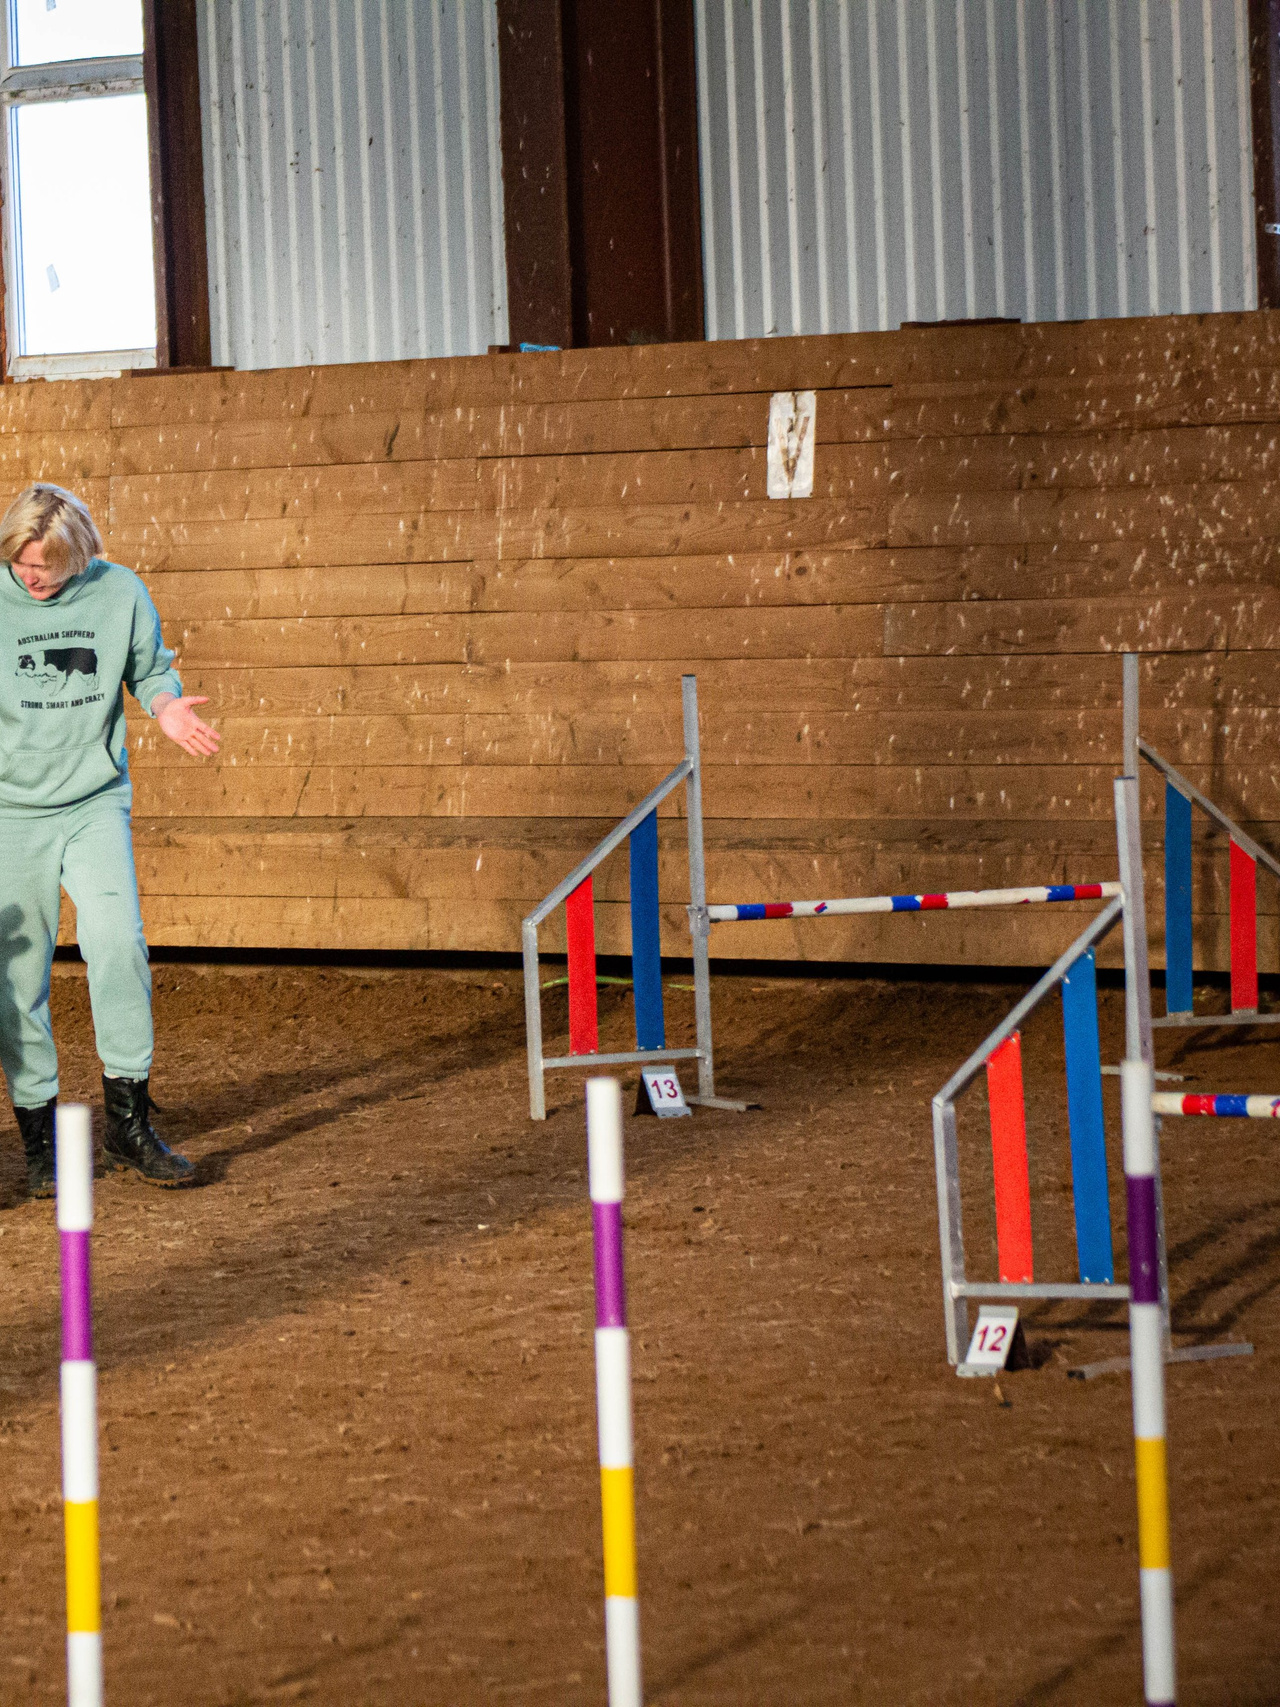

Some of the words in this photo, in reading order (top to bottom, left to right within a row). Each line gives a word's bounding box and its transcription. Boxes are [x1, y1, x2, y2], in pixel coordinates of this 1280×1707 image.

[18, 632, 60, 646] AUSTRALIAN
[61, 630, 95, 639] SHEPHERD
[46, 700, 69, 709] SMART
[71, 698, 84, 708] AND
[84, 693, 105, 703] CRAZY
[651, 1079, 678, 1099] 13
[978, 1325, 1007, 1351] 12
